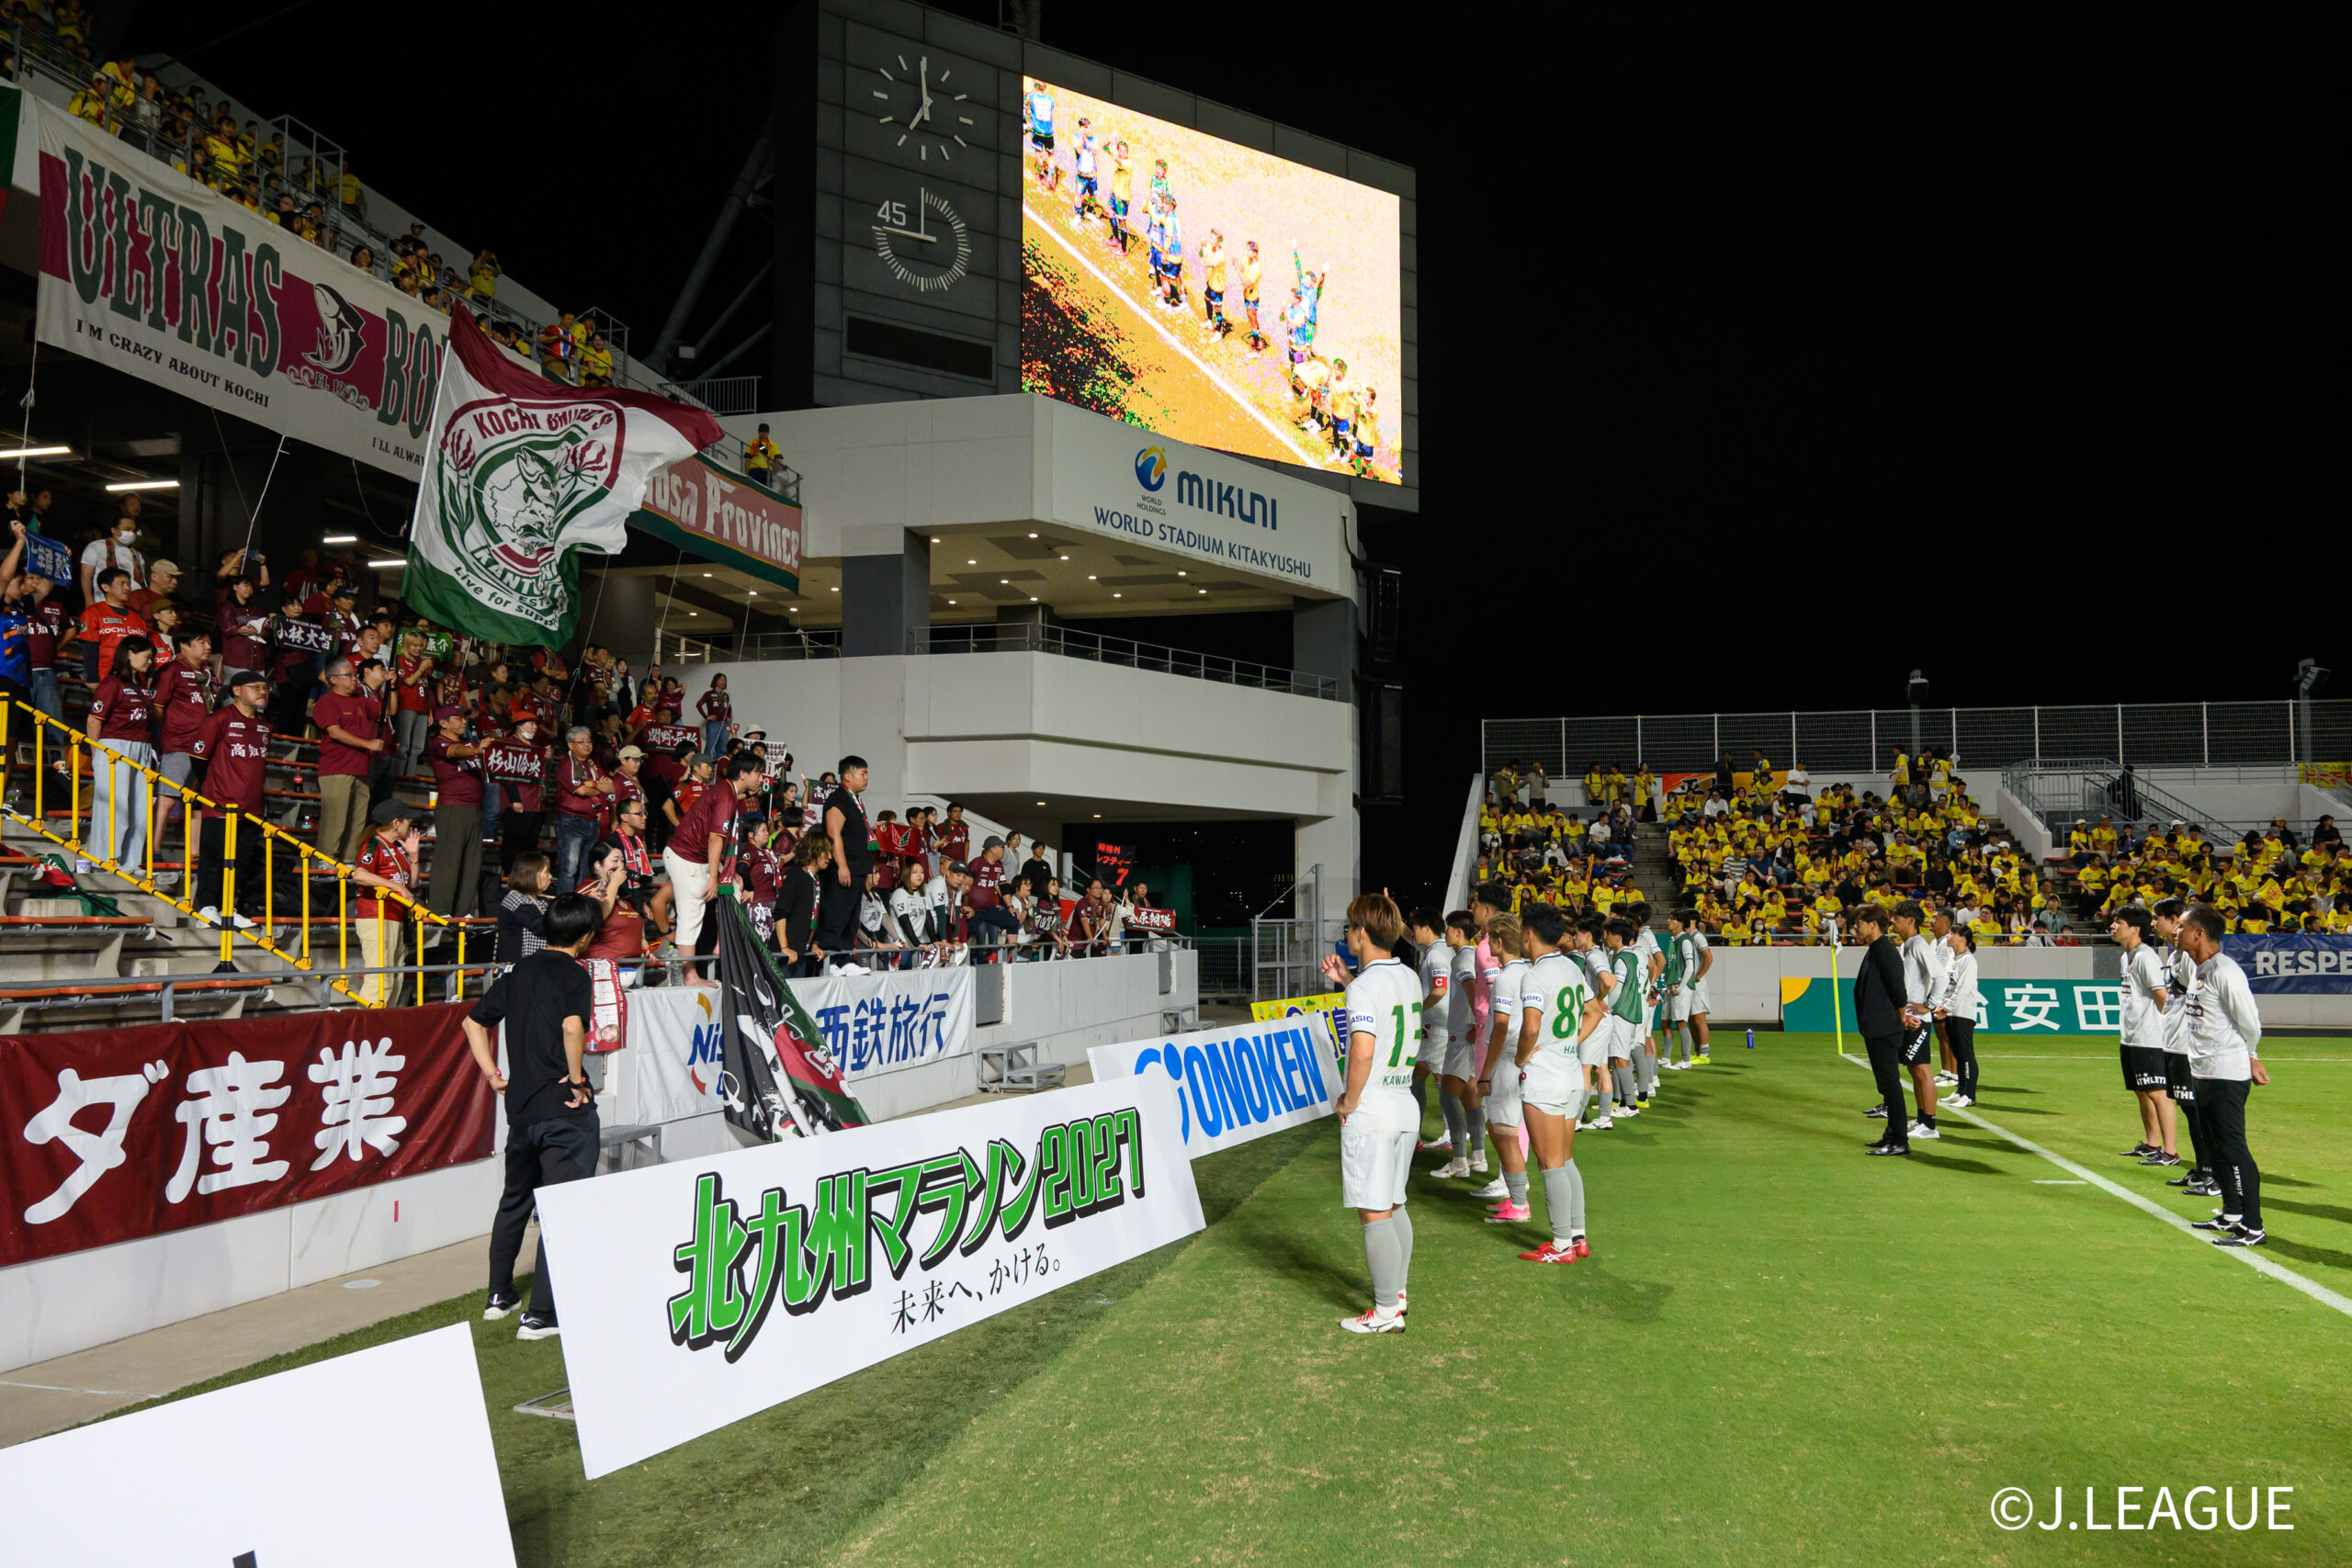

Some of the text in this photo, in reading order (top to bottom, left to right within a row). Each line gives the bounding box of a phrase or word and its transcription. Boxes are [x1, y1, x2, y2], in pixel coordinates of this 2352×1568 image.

[876, 198, 906, 227] 45
[65, 145, 447, 438] ULTRAS BO
[76, 318, 269, 408] I'M CRAZY ABOUT KOCHI
[473, 407, 541, 439] KOCHI
[1136, 502, 1168, 516] HOLDINGS
[1141, 494, 1163, 506] WORLD
[1177, 470, 1278, 531] MIKUNI
[702, 469, 802, 570] Province
[1093, 505, 1312, 579] WORLD STADIUM KITAKYUSHU
[488, 592, 512, 607] for
[99, 626, 127, 636] KOCHI
[277, 622, 333, 650] 小林大智
[487, 748, 542, 778] 杉山伶央
[762, 777, 770, 792] 8
[1115, 868, 1129, 887] 7
[1435, 977, 1443, 987] C
[816, 993, 950, 1073] 西鉄旅行
[1350, 1015, 1374, 1024] ASIO
[1387, 1001, 1422, 1067] 13
[1906, 1030, 1928, 1062] ATHLETA
[24, 1036, 407, 1224] ダ産業
[666, 1106, 1145, 1364] 北九州マラソン2027
[890, 1242, 1062, 1336] 未来へ、かける。
